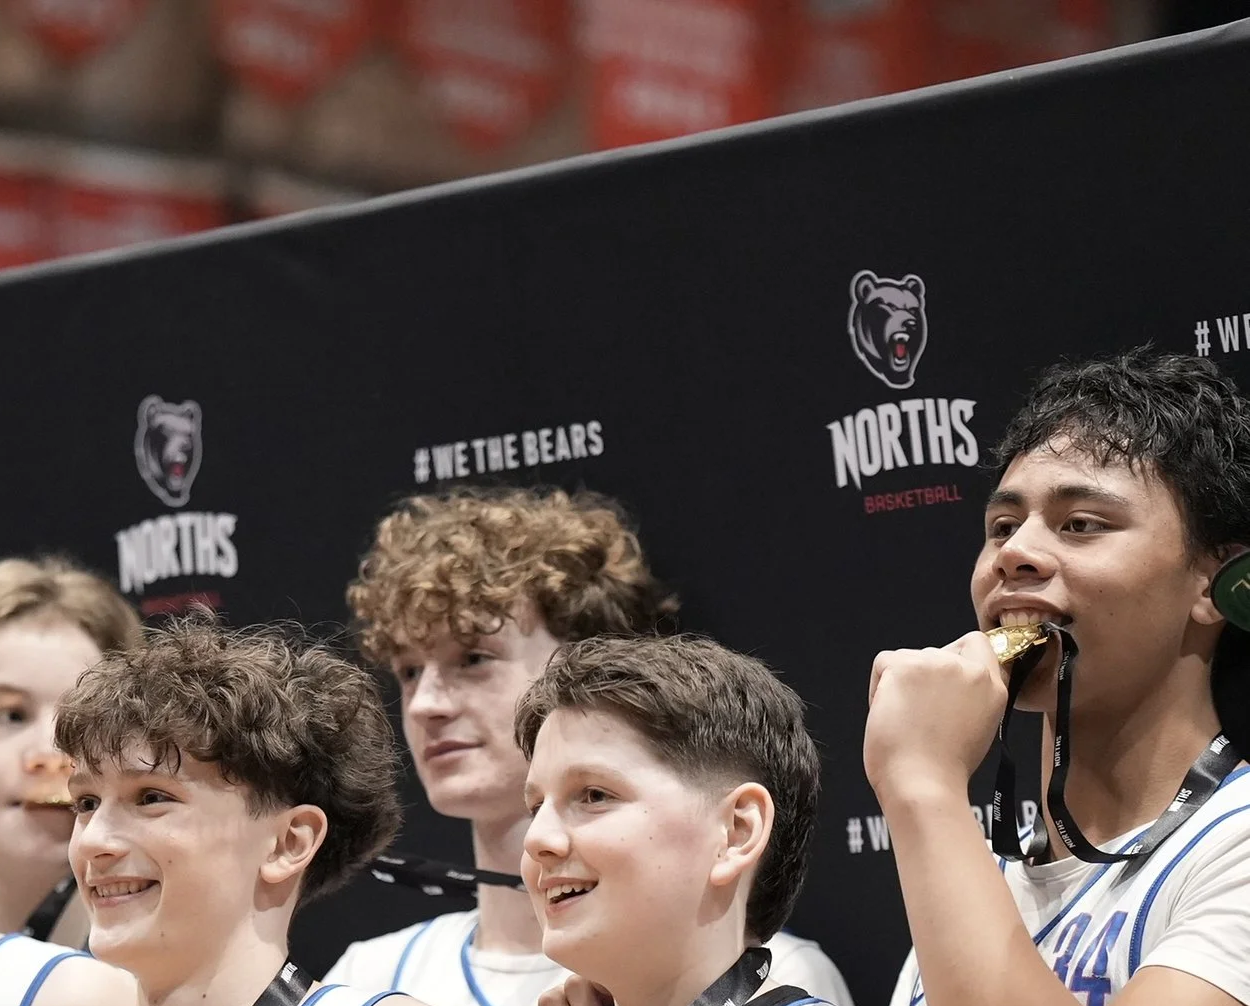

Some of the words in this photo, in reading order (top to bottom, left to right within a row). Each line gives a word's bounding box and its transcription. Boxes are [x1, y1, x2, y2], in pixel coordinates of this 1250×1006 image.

[471, 432, 520, 474] THE
[522, 420, 605, 467] BEARS
[826, 398, 979, 491] NORTHS
[864, 485, 962, 513] BASKETBALL
[115, 511, 239, 594] NORTHS
[1054, 735, 1062, 768] NORTHS
[992, 790, 1003, 822] NORTHS
[846, 815, 890, 854] #W
[1055, 819, 1076, 849] NORTHS
